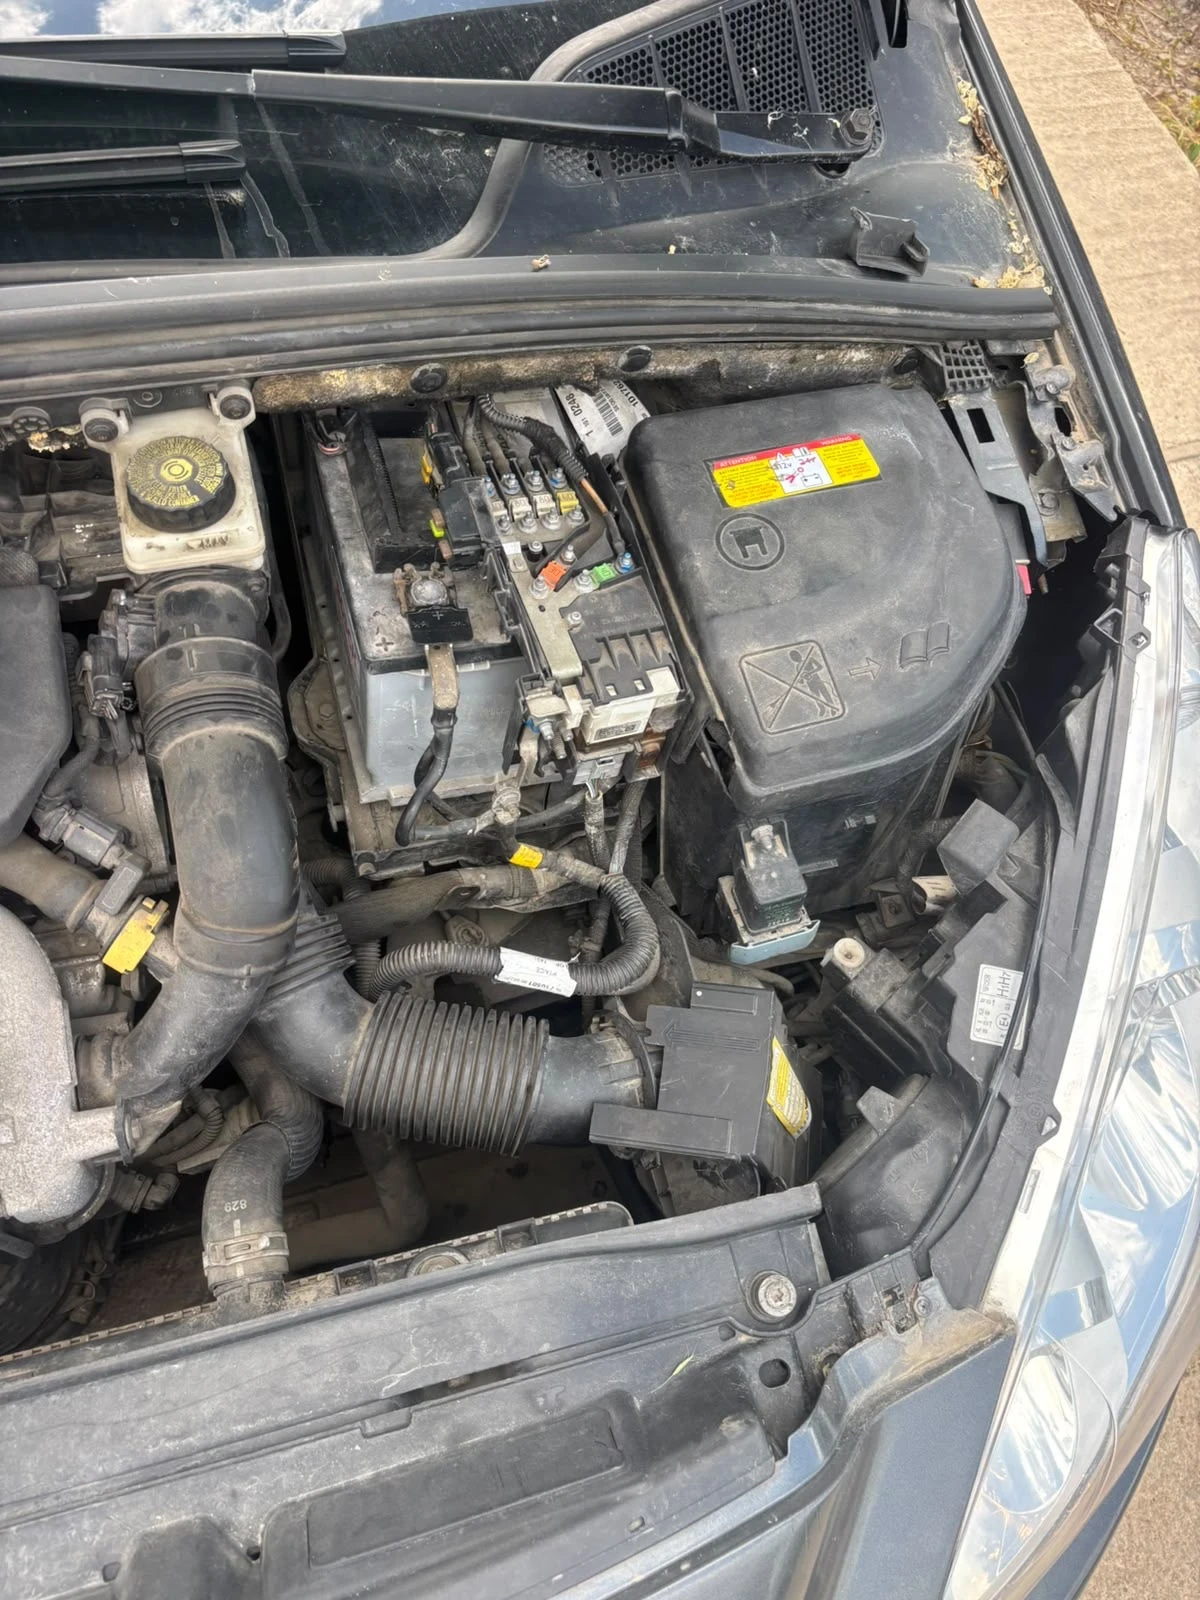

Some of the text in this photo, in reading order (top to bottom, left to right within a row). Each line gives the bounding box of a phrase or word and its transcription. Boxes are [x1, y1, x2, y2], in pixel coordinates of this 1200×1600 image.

[613, 379, 639, 407] 1D1762
[565, 393, 583, 417] 0248
[821, 435, 852, 446] WARNING
[720, 455, 757, 467] ATTENTION
[224, 1199, 247, 1213] 829
